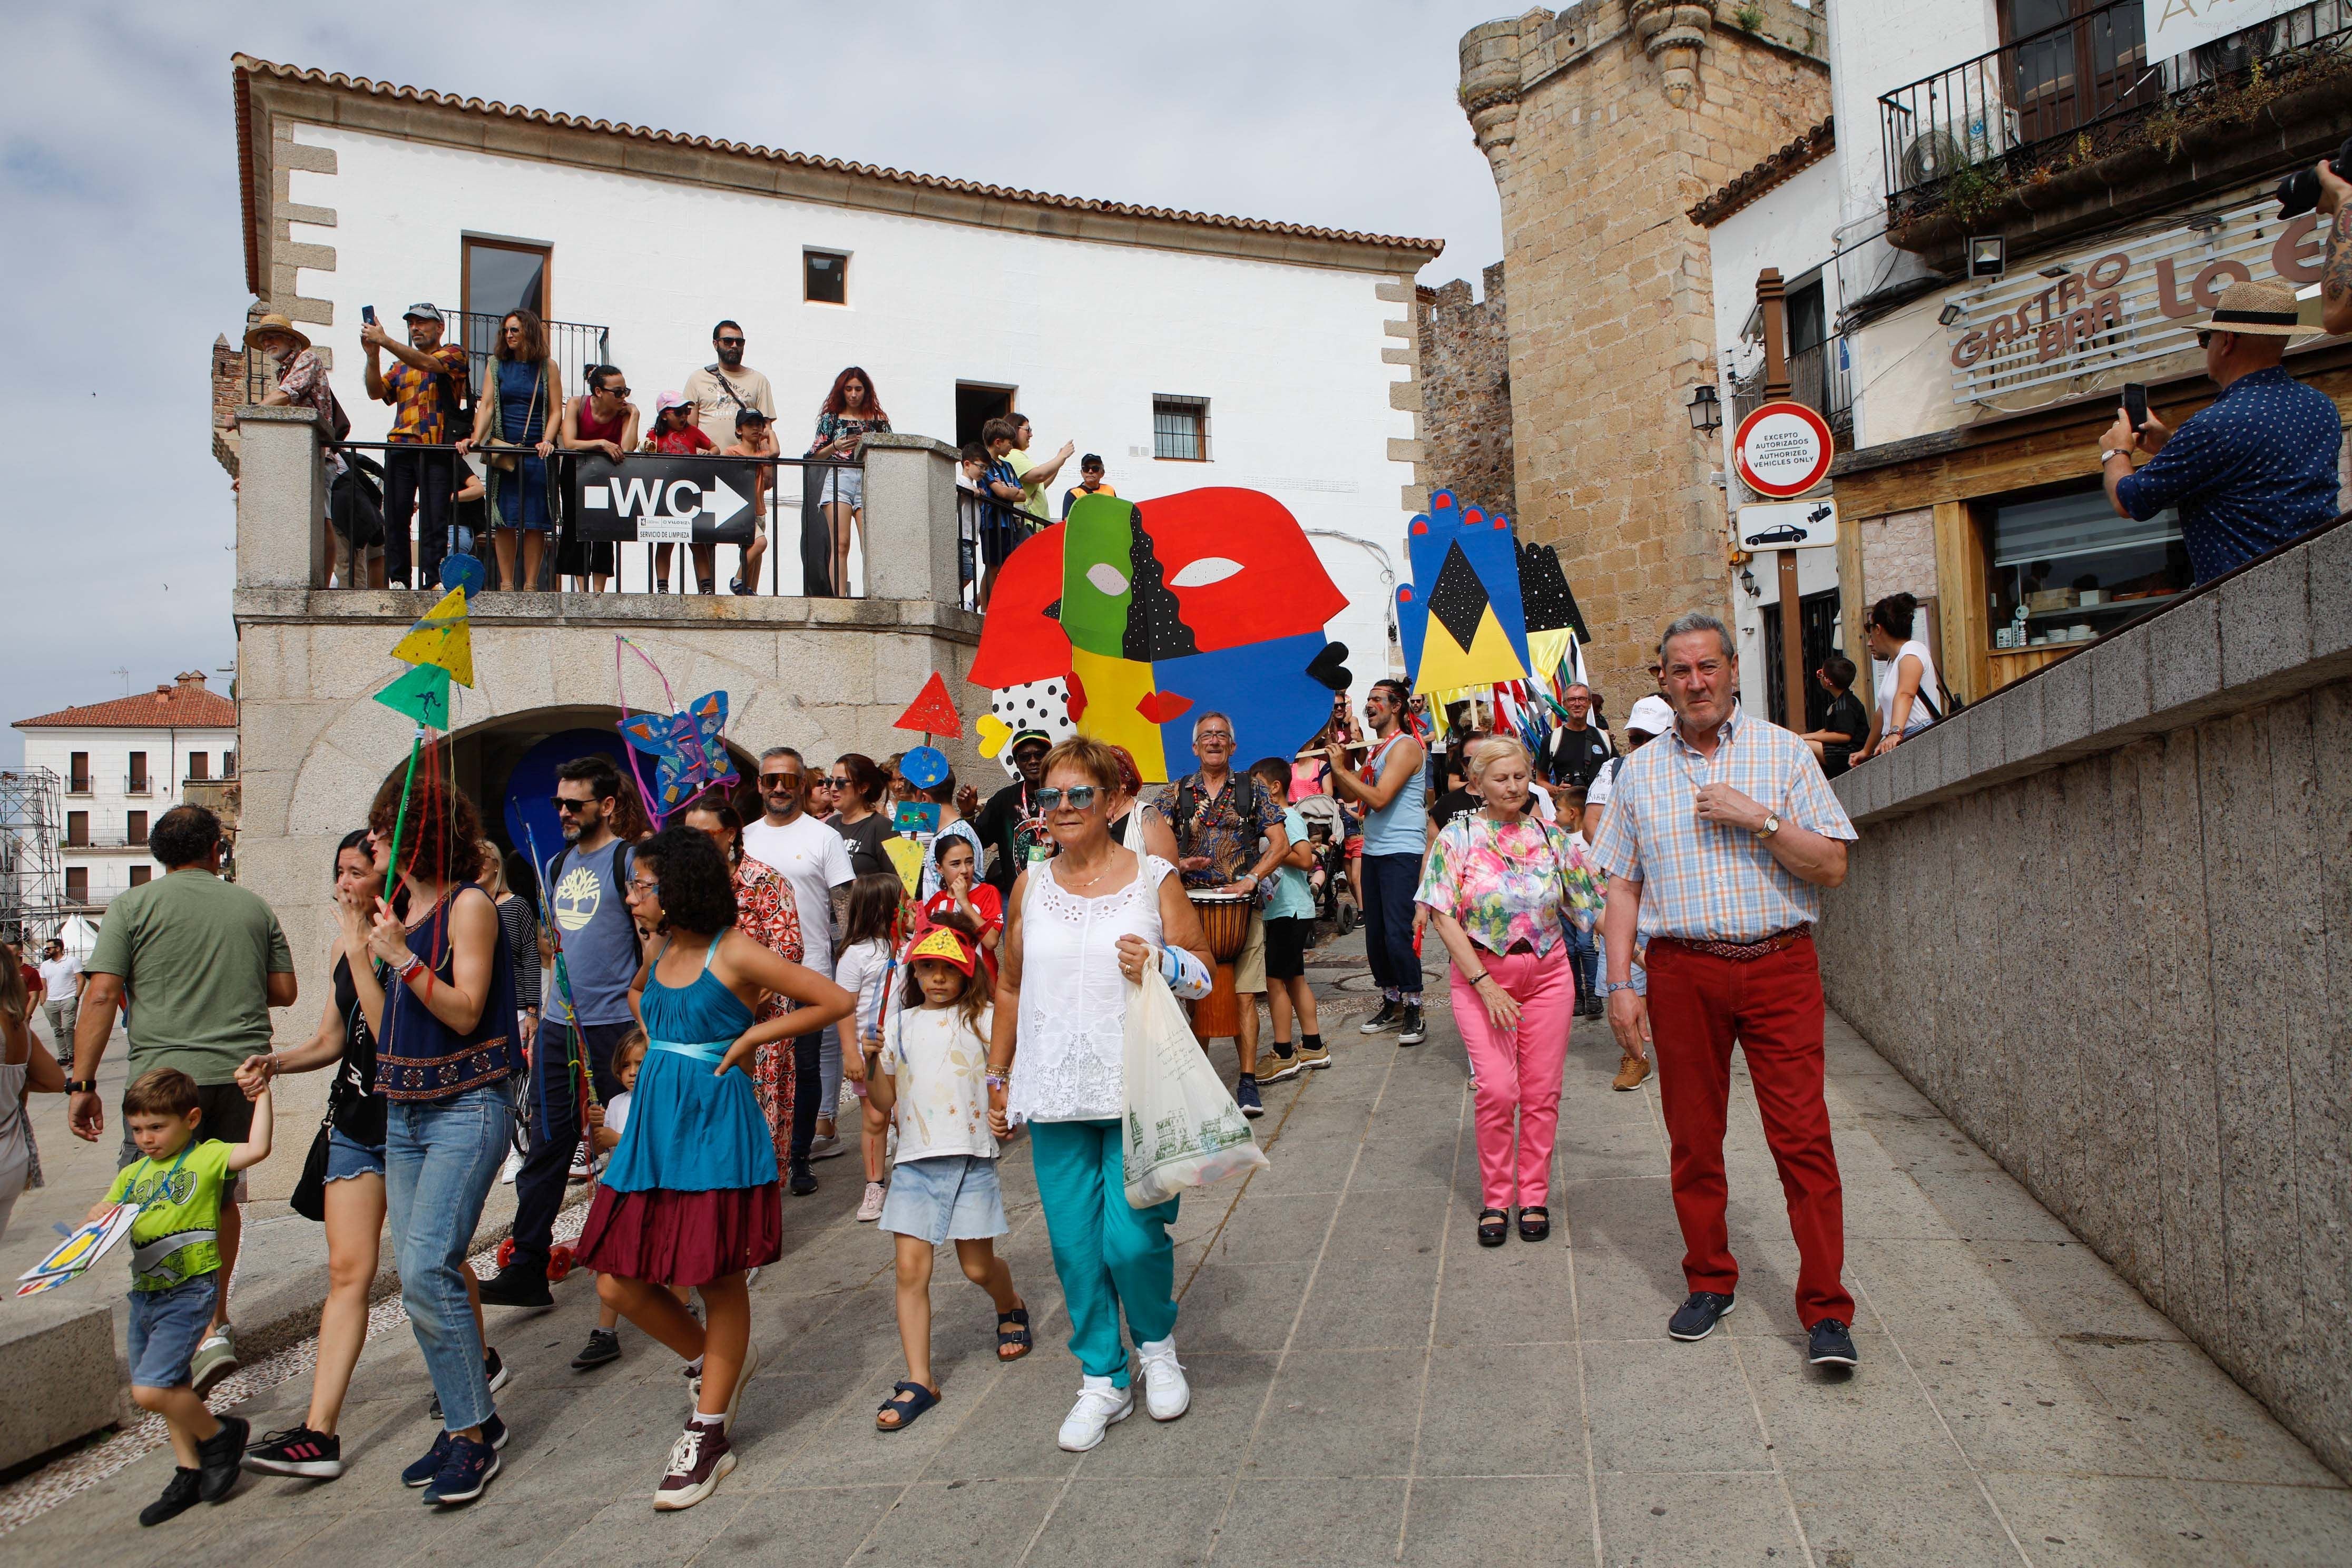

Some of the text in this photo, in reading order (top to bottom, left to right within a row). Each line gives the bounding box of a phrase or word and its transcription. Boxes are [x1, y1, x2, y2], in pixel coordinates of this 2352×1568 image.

[1951, 252, 2130, 368] GASTRO
[2038, 291, 2122, 364] BAR
[1764, 432, 1798, 442] EXCEPTO
[1756, 438, 1809, 449] AUTORIZADOS
[1759, 449, 1807, 460] AUTHORIZED
[1753, 459, 1791, 468] VEHICLES
[610, 477, 701, 519] WC
